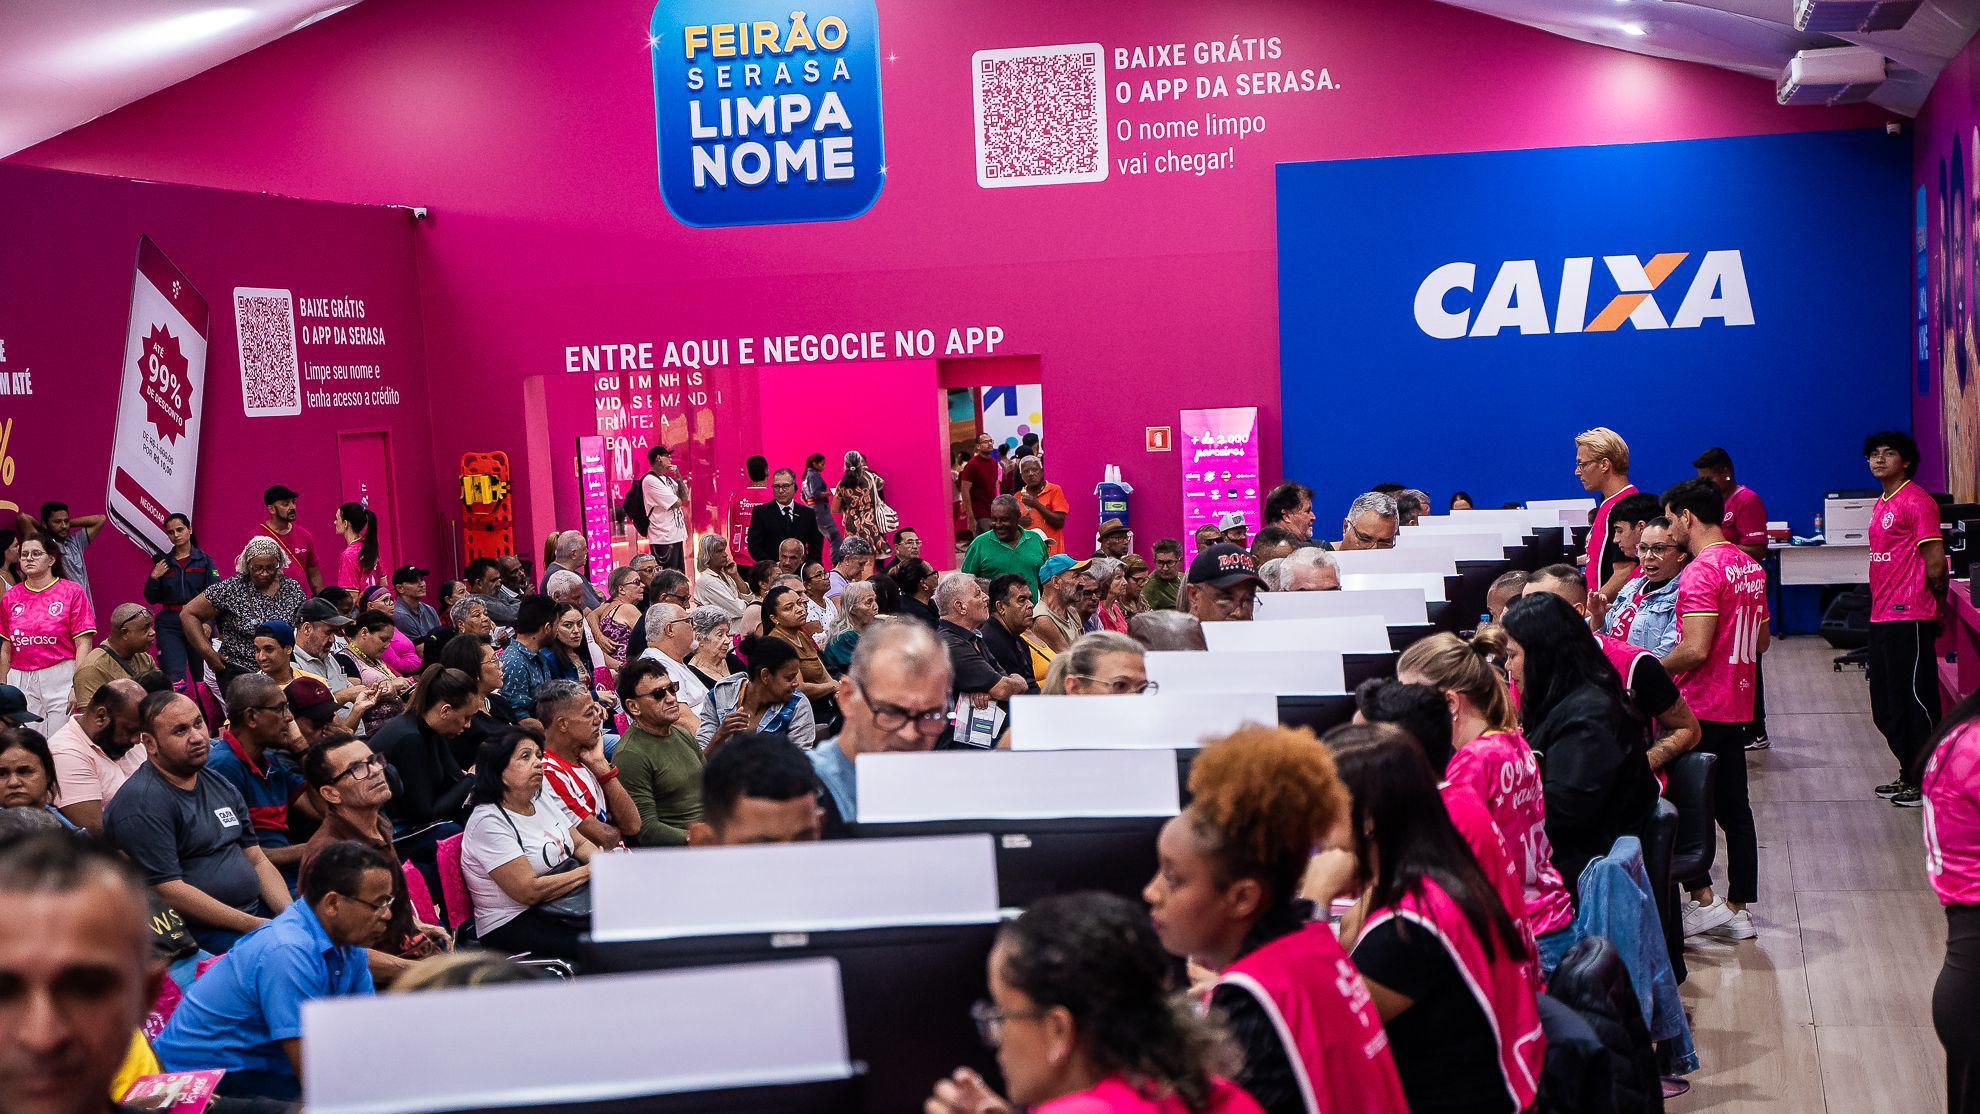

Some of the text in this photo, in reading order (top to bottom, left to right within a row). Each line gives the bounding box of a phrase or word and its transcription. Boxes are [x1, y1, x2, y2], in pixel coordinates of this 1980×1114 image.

[685, 11, 849, 59] FEIRÃO
[1115, 35, 1282, 69] BAIXE GRÁTIS
[688, 58, 850, 89] SERASA
[1115, 68, 1341, 103] O APP DA SERASA.
[690, 91, 852, 138] LIMPA
[1117, 113, 1266, 141] O nome limpo
[692, 137, 854, 187] NOME
[1118, 147, 1235, 176] vai chegar!
[300, 295, 365, 318] BAIXE GRÁTIS
[1413, 249, 1756, 339] CAIXA
[303, 326, 386, 345] O APP DA SERASA
[565, 326, 1004, 372] ENTRE AQUI E NEGOCIE NO APP
[13, 368, 32, 394] ATÉ
[149, 354, 182, 409] 99%
[305, 362, 380, 384] Limpe seu nome e
[155, 393, 183, 427] DESCONTO
[307, 386, 400, 408] tenha acesso a crédito
[140, 496, 165, 524] NEGOCIAR
[16, 634, 57, 646] serasa
